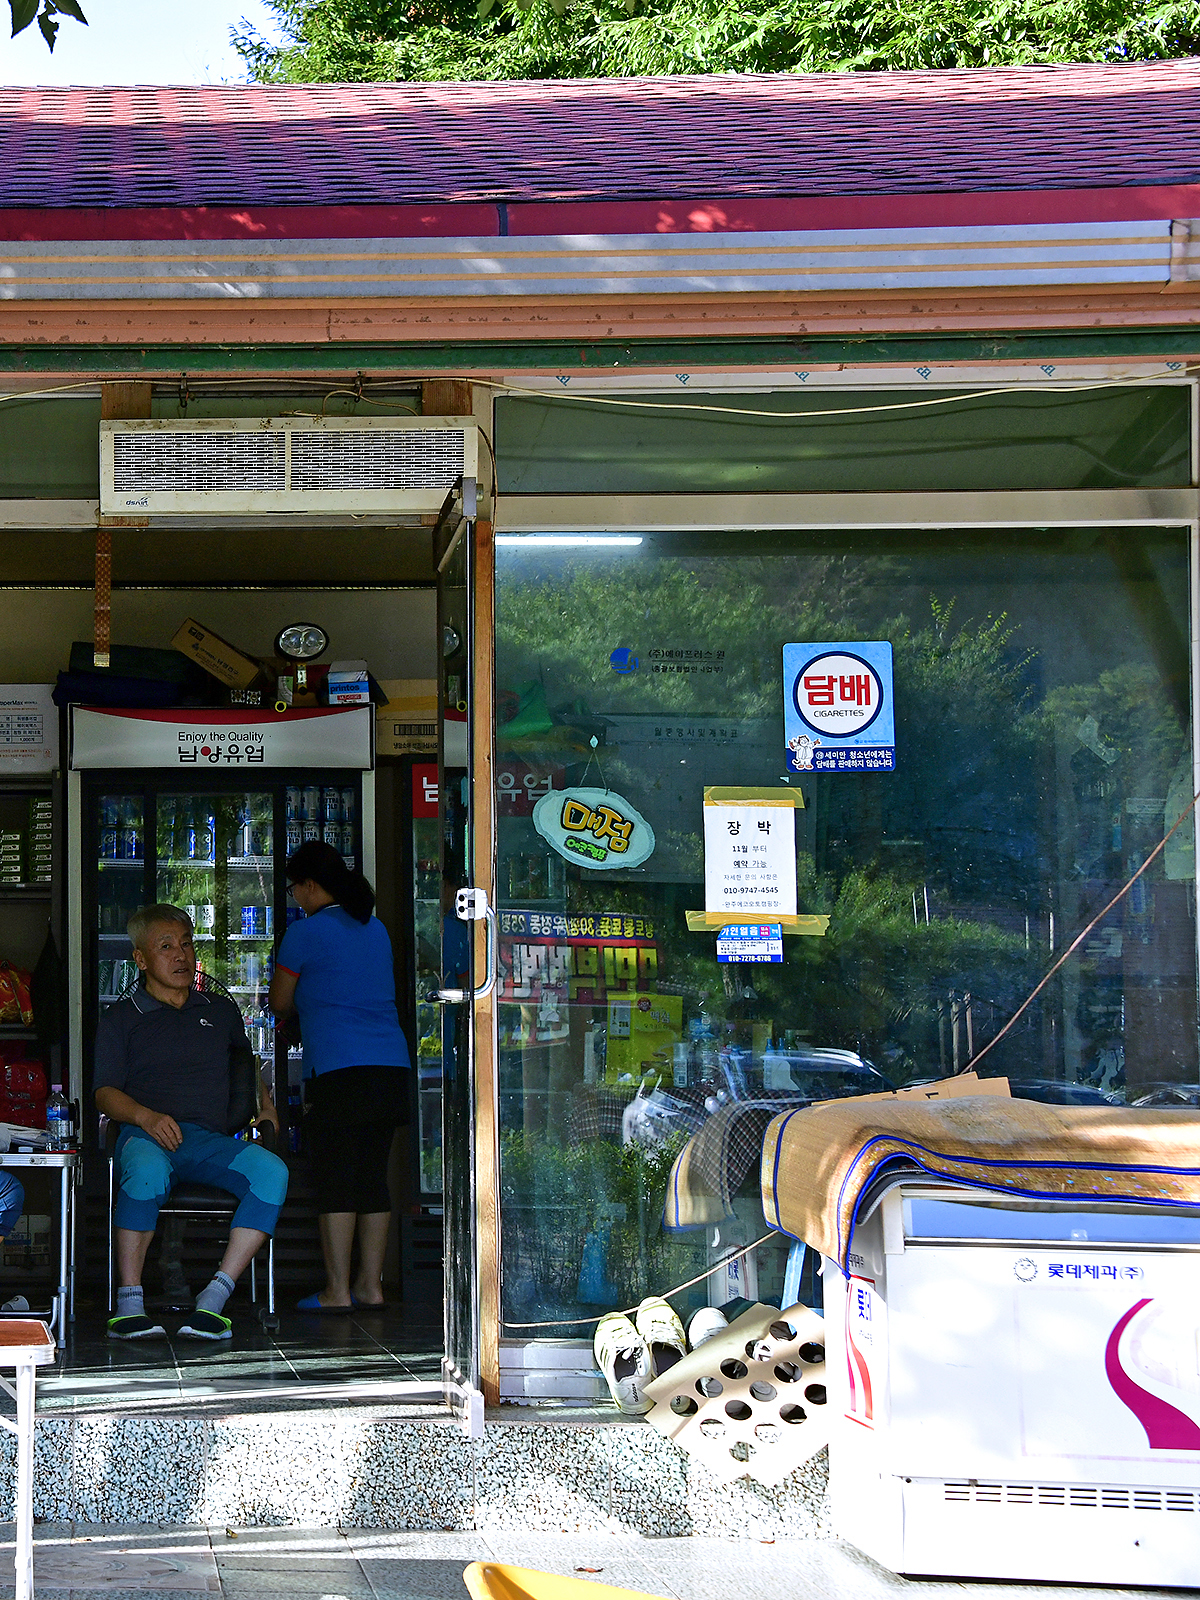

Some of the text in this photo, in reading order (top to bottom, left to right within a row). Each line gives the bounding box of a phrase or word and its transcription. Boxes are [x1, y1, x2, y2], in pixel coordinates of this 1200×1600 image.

[330, 684, 360, 693] printos
[804, 674, 871, 706] 담배
[813, 710, 864, 718] CIGARETTES
[178, 731, 264, 744] Enjoy the Quality
[178, 744, 264, 763] 남양유업
[561, 798, 634, 853] 매점
[727, 820, 772, 836] 장 박
[732, 845, 767, 853] 11월 부터
[733, 860, 767, 868] 예약 가능
[1048, 1263, 1145, 1280] 롯데제과(주)
